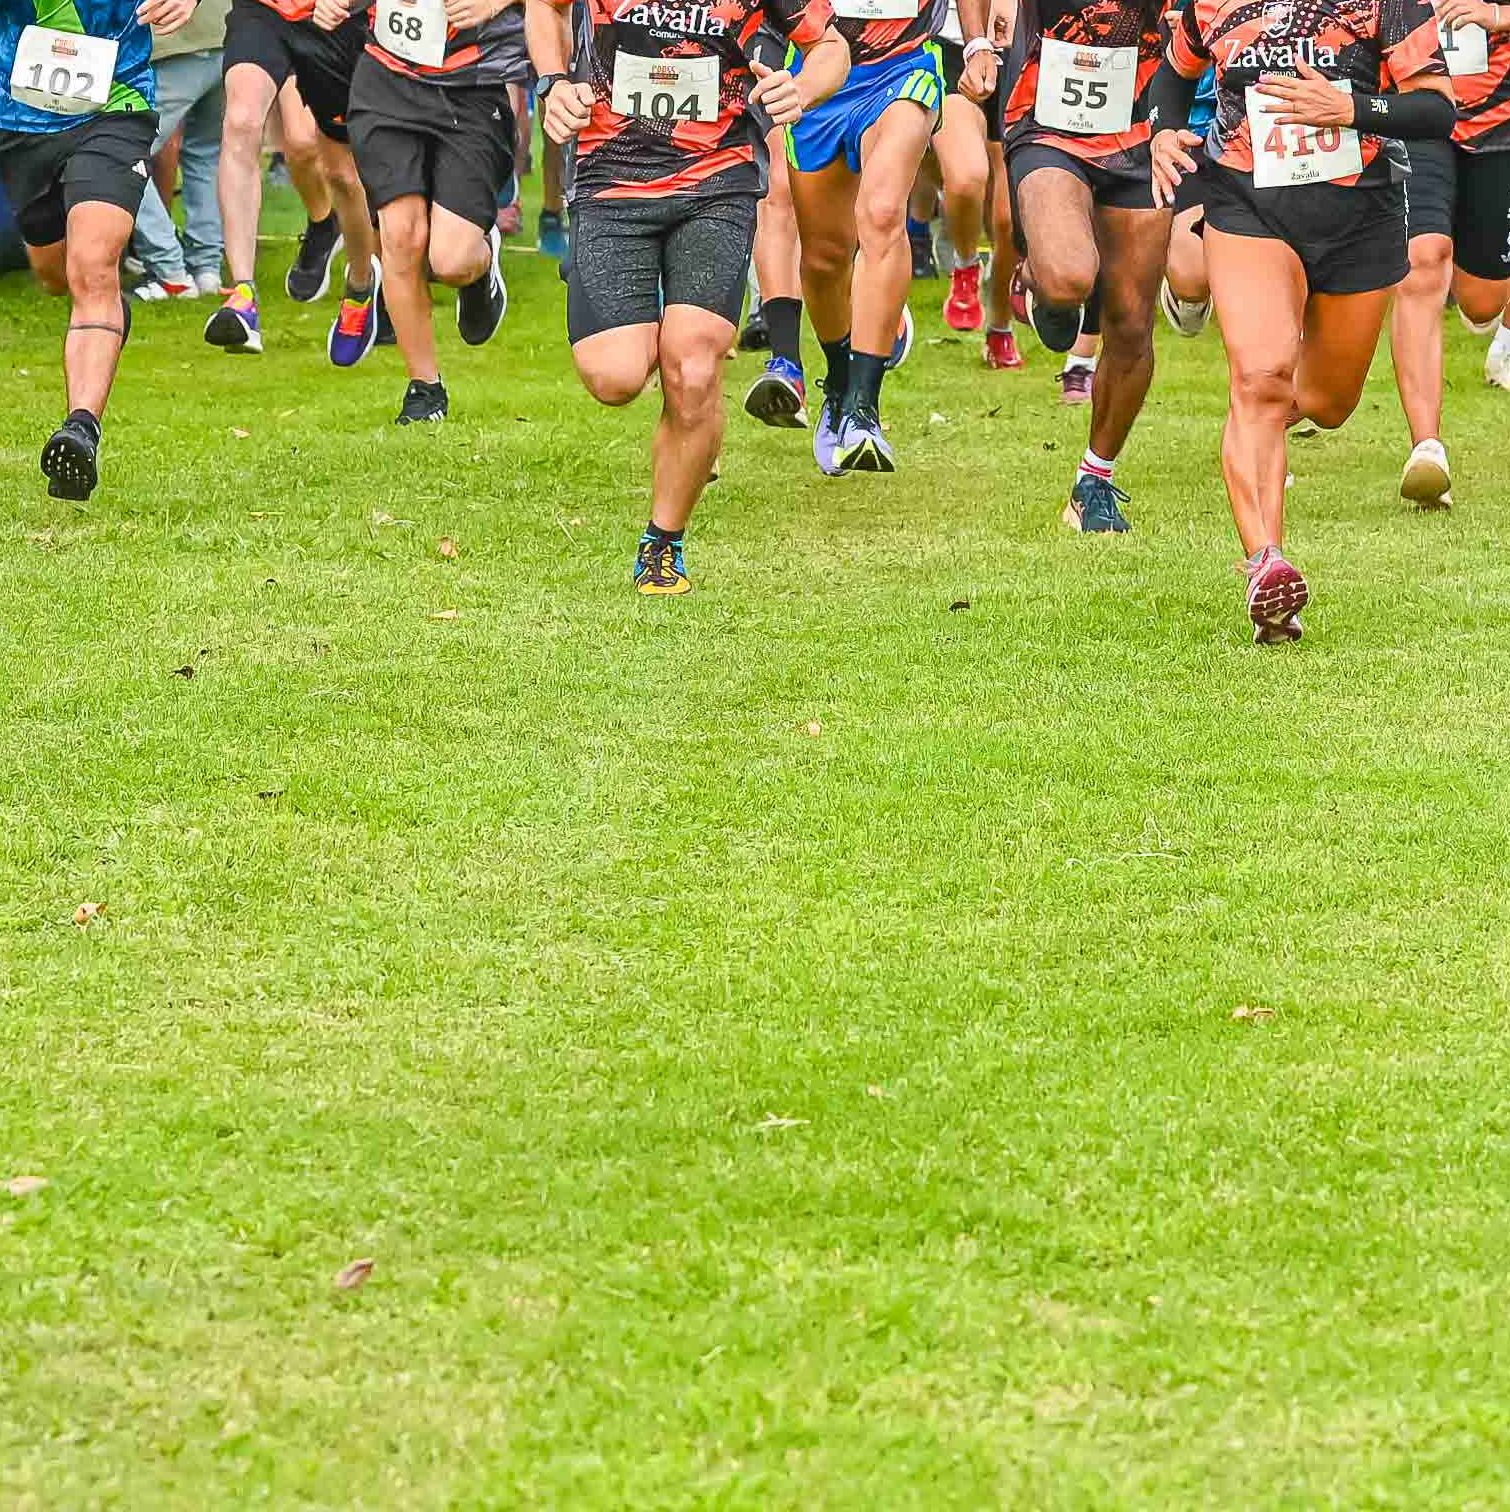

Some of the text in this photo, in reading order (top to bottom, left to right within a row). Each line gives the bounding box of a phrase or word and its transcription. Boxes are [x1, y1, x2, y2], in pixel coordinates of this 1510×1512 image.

[388, 10, 423, 42] 68
[1224, 38, 1339, 69] Zavalla
[28, 63, 95, 104] 102
[1061, 77, 1109, 109] 55
[626, 91, 703, 121] 104
